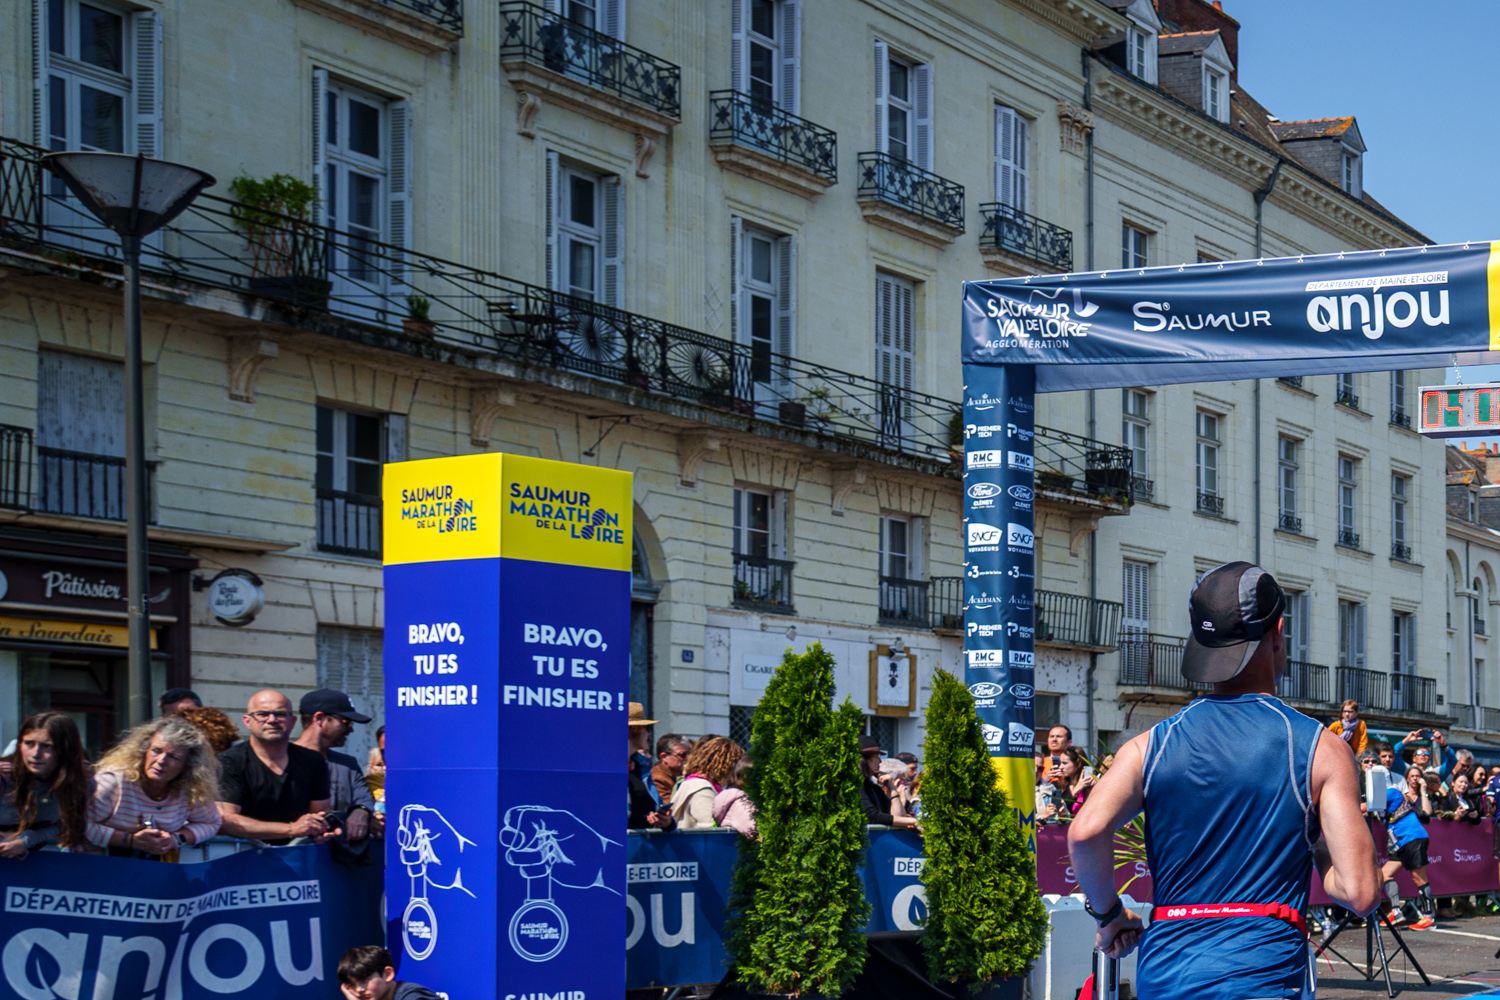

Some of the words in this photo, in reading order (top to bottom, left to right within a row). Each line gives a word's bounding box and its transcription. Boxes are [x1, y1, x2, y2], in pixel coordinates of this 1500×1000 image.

[1308, 277, 1366, 290] DÉPARTEMENT
[1379, 273, 1447, 285] MAINE-ET-LOIRE
[988, 298, 1070, 321] SAUMUR
[1132, 301, 1272, 332] SAUMUR
[1306, 289, 1450, 340] anjou
[996, 318, 1026, 337] VAL
[1026, 319, 1040, 331] DE
[1039, 319, 1092, 338] LOIRE
[985, 338, 1070, 350] AGGLOMÉRATION
[973, 453, 993, 462] RMC
[1015, 454, 1030, 466] RMC
[402, 485, 453, 503] SAUMUR
[510, 483, 590, 507] SAUMUR
[973, 485, 994, 496] Ford
[1014, 487, 1031, 499] Ford
[402, 498, 473, 520] MARATHON
[510, 500, 618, 527] MARATHON
[417, 520, 426, 529] DE
[427, 520, 436, 528] LA
[439, 516, 477, 534] LOIRE
[536, 519, 549, 529] DE
[553, 521, 566, 531] LA
[571, 525, 624, 544] LOIRE
[970, 531, 998, 542] SNCF
[1010, 532, 1033, 544] SNCF
[972, 565, 980, 578] 3
[1012, 565, 1020, 578] 3
[42, 571, 121, 599] Pâtissier
[409, 622, 465, 645] BRAVO,
[524, 623, 608, 651] BRAVO,
[413, 655, 434, 675] TU
[438, 654, 459, 674] ES
[975, 653, 995, 661] RMC
[1014, 653, 1032, 663] RMC
[533, 656, 565, 676] TU
[571, 659, 599, 679] ES
[745, 663, 776, 675] CIGARE
[398, 685, 469, 706] FINISHER
[504, 685, 612, 710] FINISHER
[974, 685, 994, 696] Ford
[628, 865, 697, 880] E-ET-LOIRE
[11, 889, 174, 920] DÉPARTEMENT
[175, 900, 195, 920] DE
